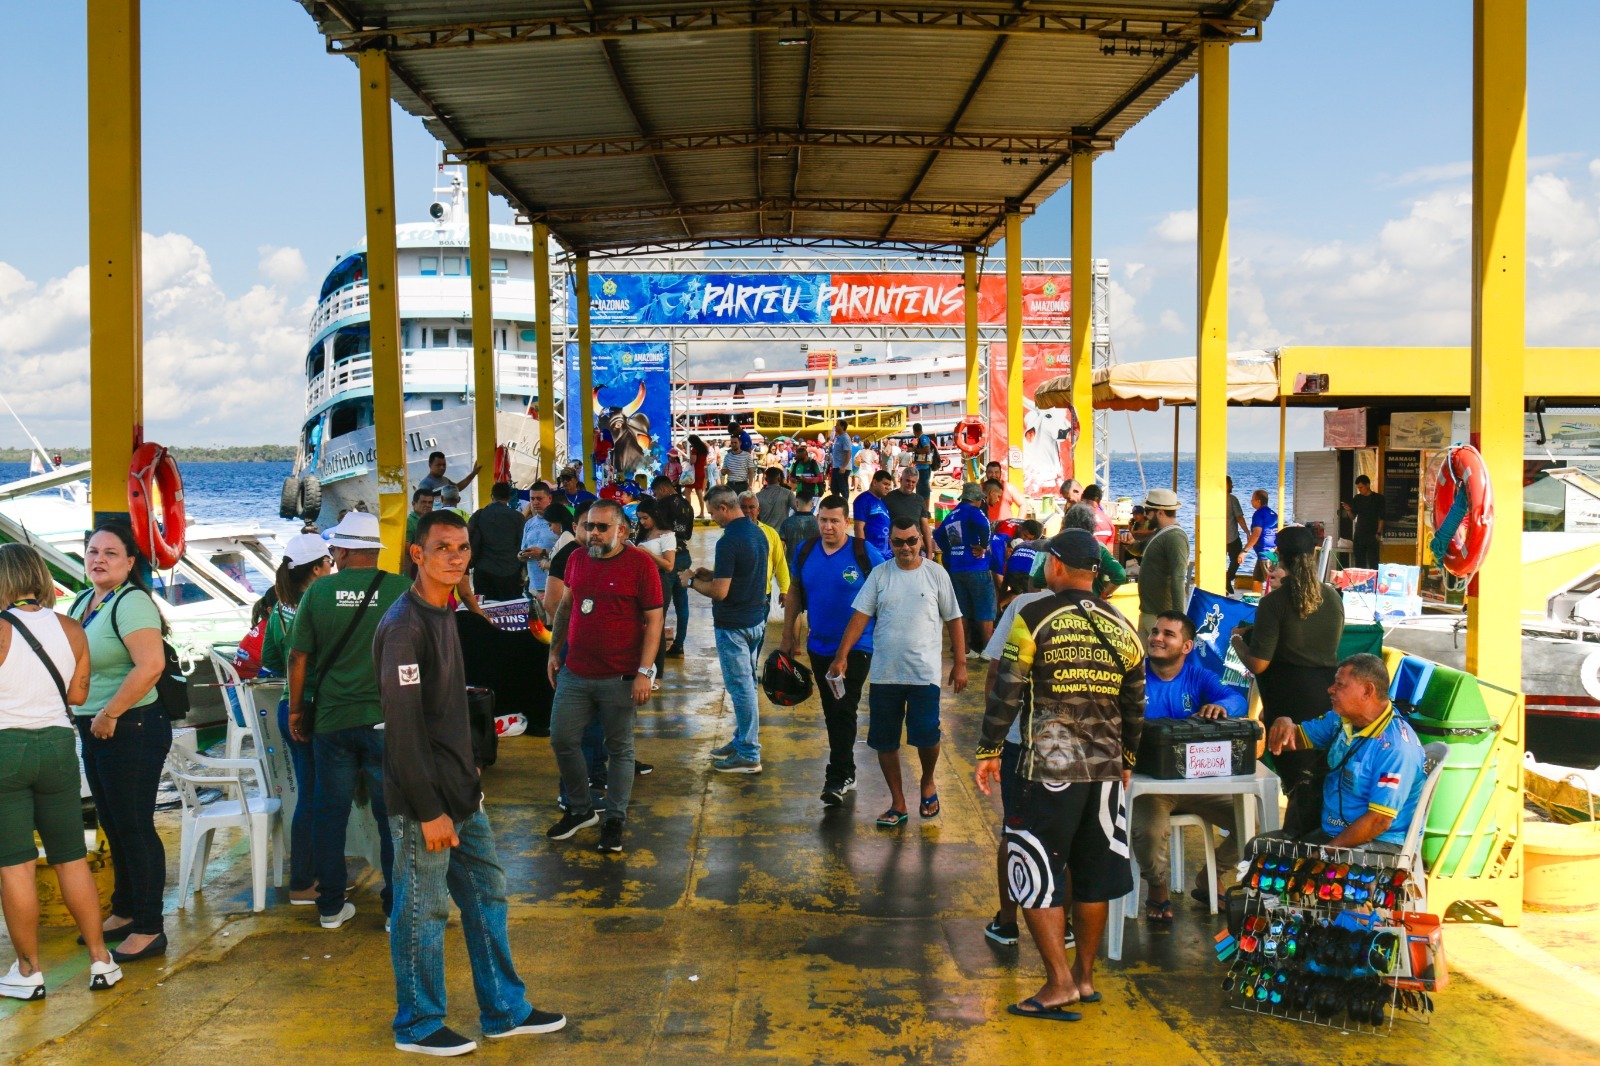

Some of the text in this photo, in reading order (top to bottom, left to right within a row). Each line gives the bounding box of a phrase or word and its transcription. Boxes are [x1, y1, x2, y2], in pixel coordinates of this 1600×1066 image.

[1030, 300, 1069, 312] AMAZONAS
[634, 354, 664, 362] AMAZONAS
[1052, 634, 1086, 644] MANAUS
[1052, 684, 1088, 694] MANAUS
[1189, 756, 1226, 769] BARBOSA
